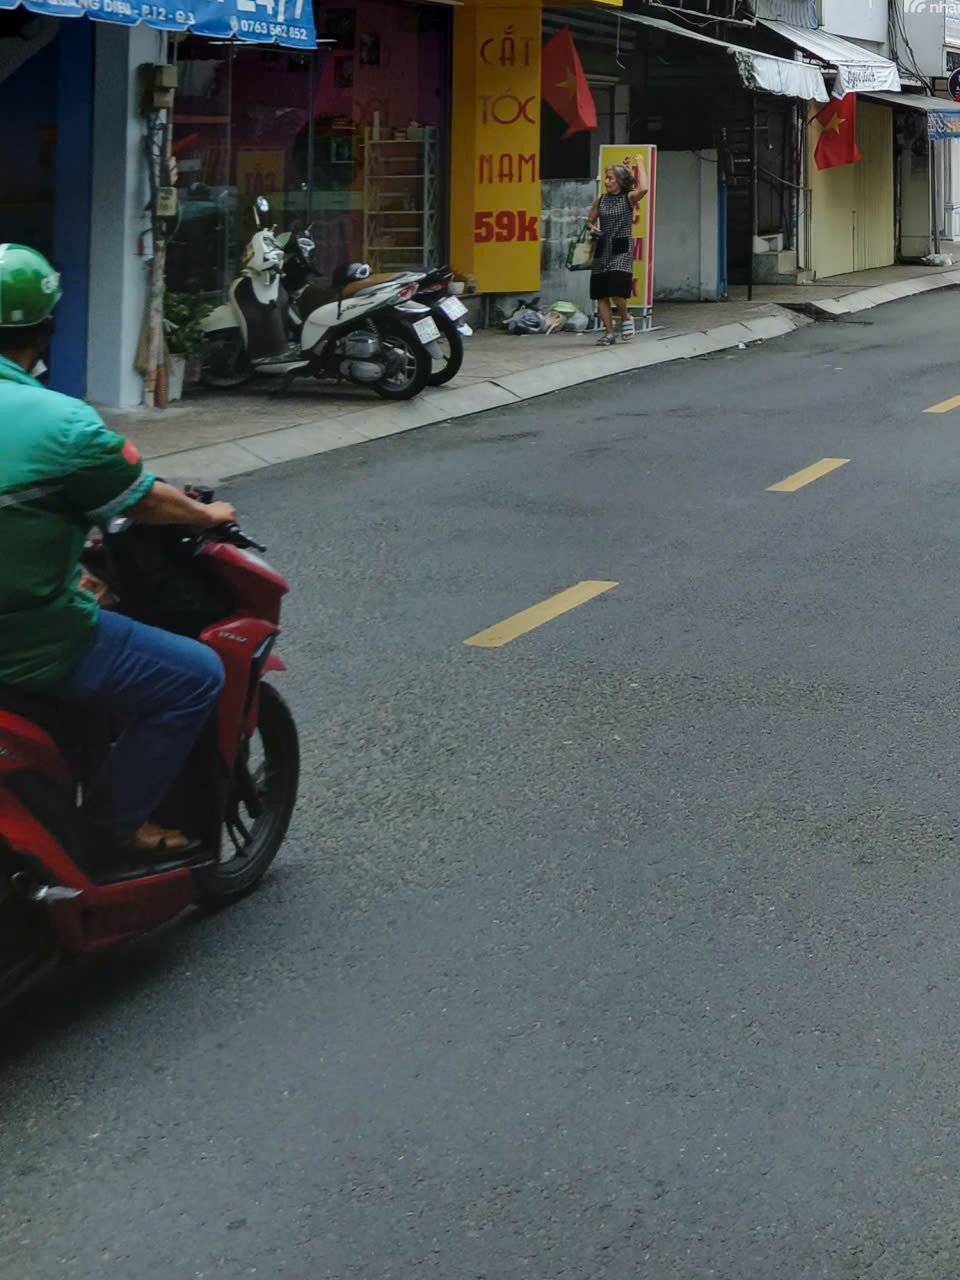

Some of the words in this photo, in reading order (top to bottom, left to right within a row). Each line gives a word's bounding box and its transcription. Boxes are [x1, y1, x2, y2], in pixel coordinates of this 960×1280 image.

[240, 19, 268, 35] 0763
[269, 21, 288, 38] 562
[289, 25, 308, 41] 852
[480, 24, 533, 68] CẮT
[479, 86, 536, 124] TÓC
[479, 152, 536, 184] NAM
